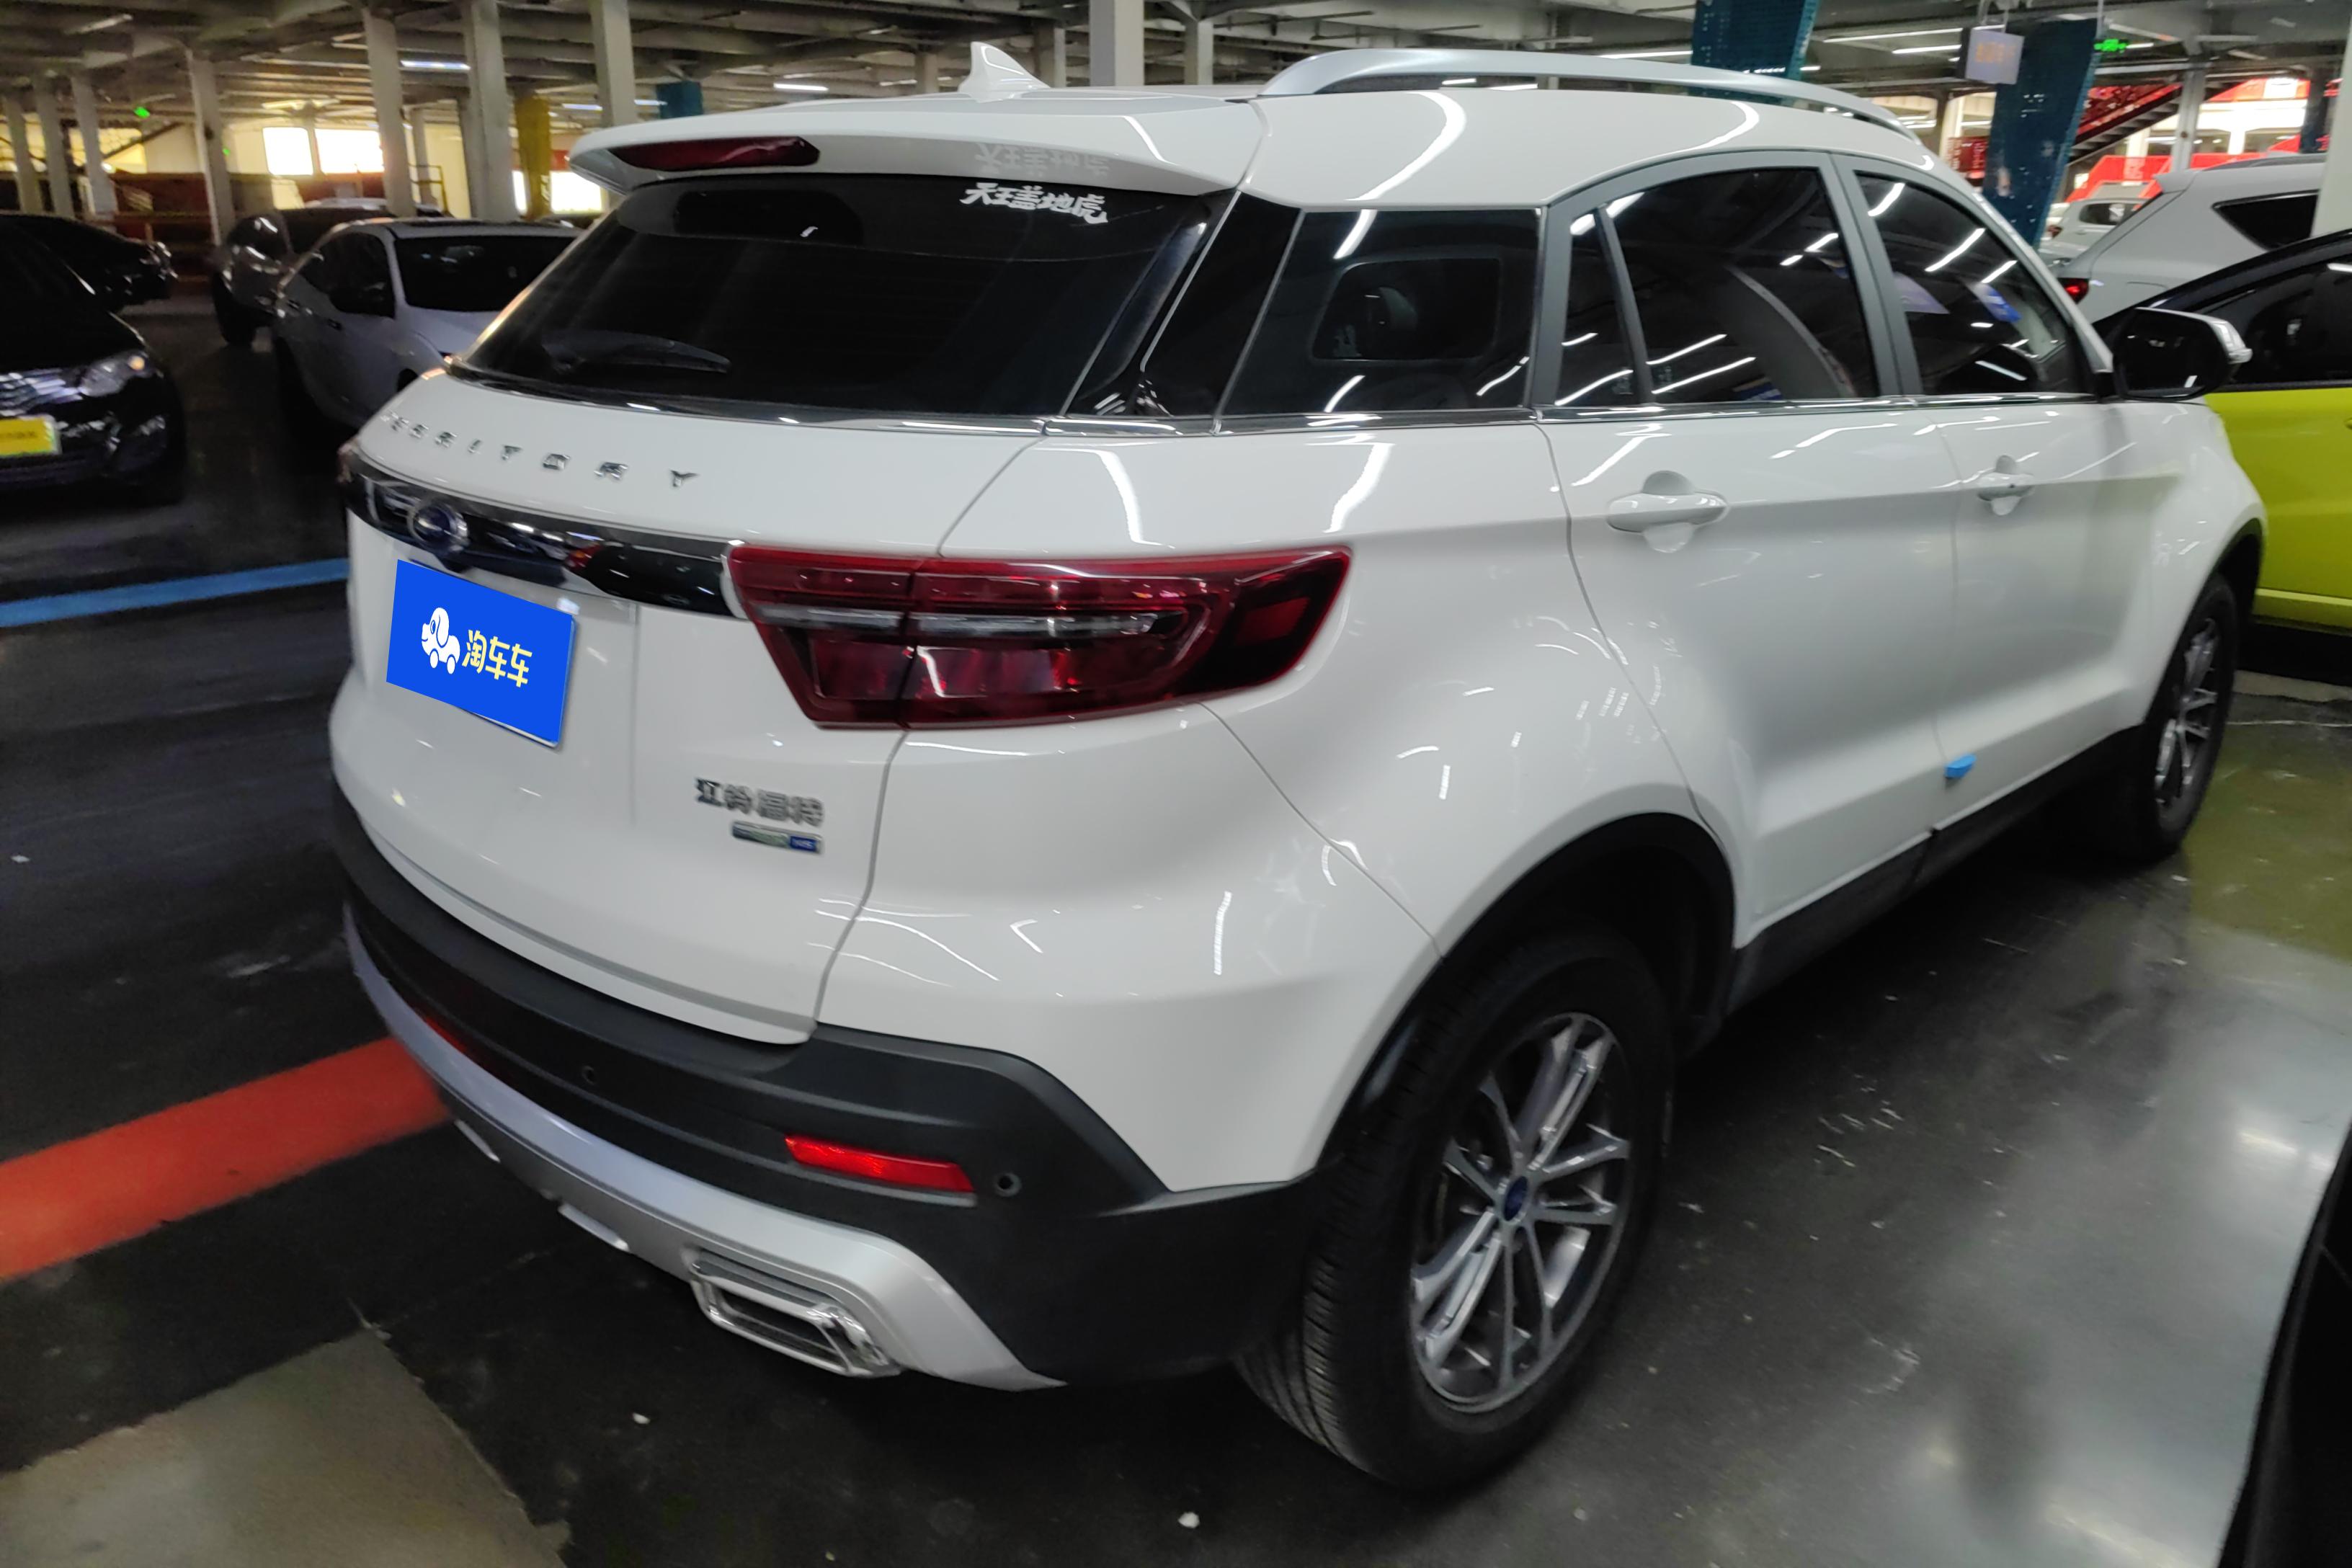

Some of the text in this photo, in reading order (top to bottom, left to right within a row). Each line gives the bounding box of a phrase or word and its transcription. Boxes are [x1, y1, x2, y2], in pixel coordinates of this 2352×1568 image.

[960, 182, 1108, 224] 天王盖地虎
